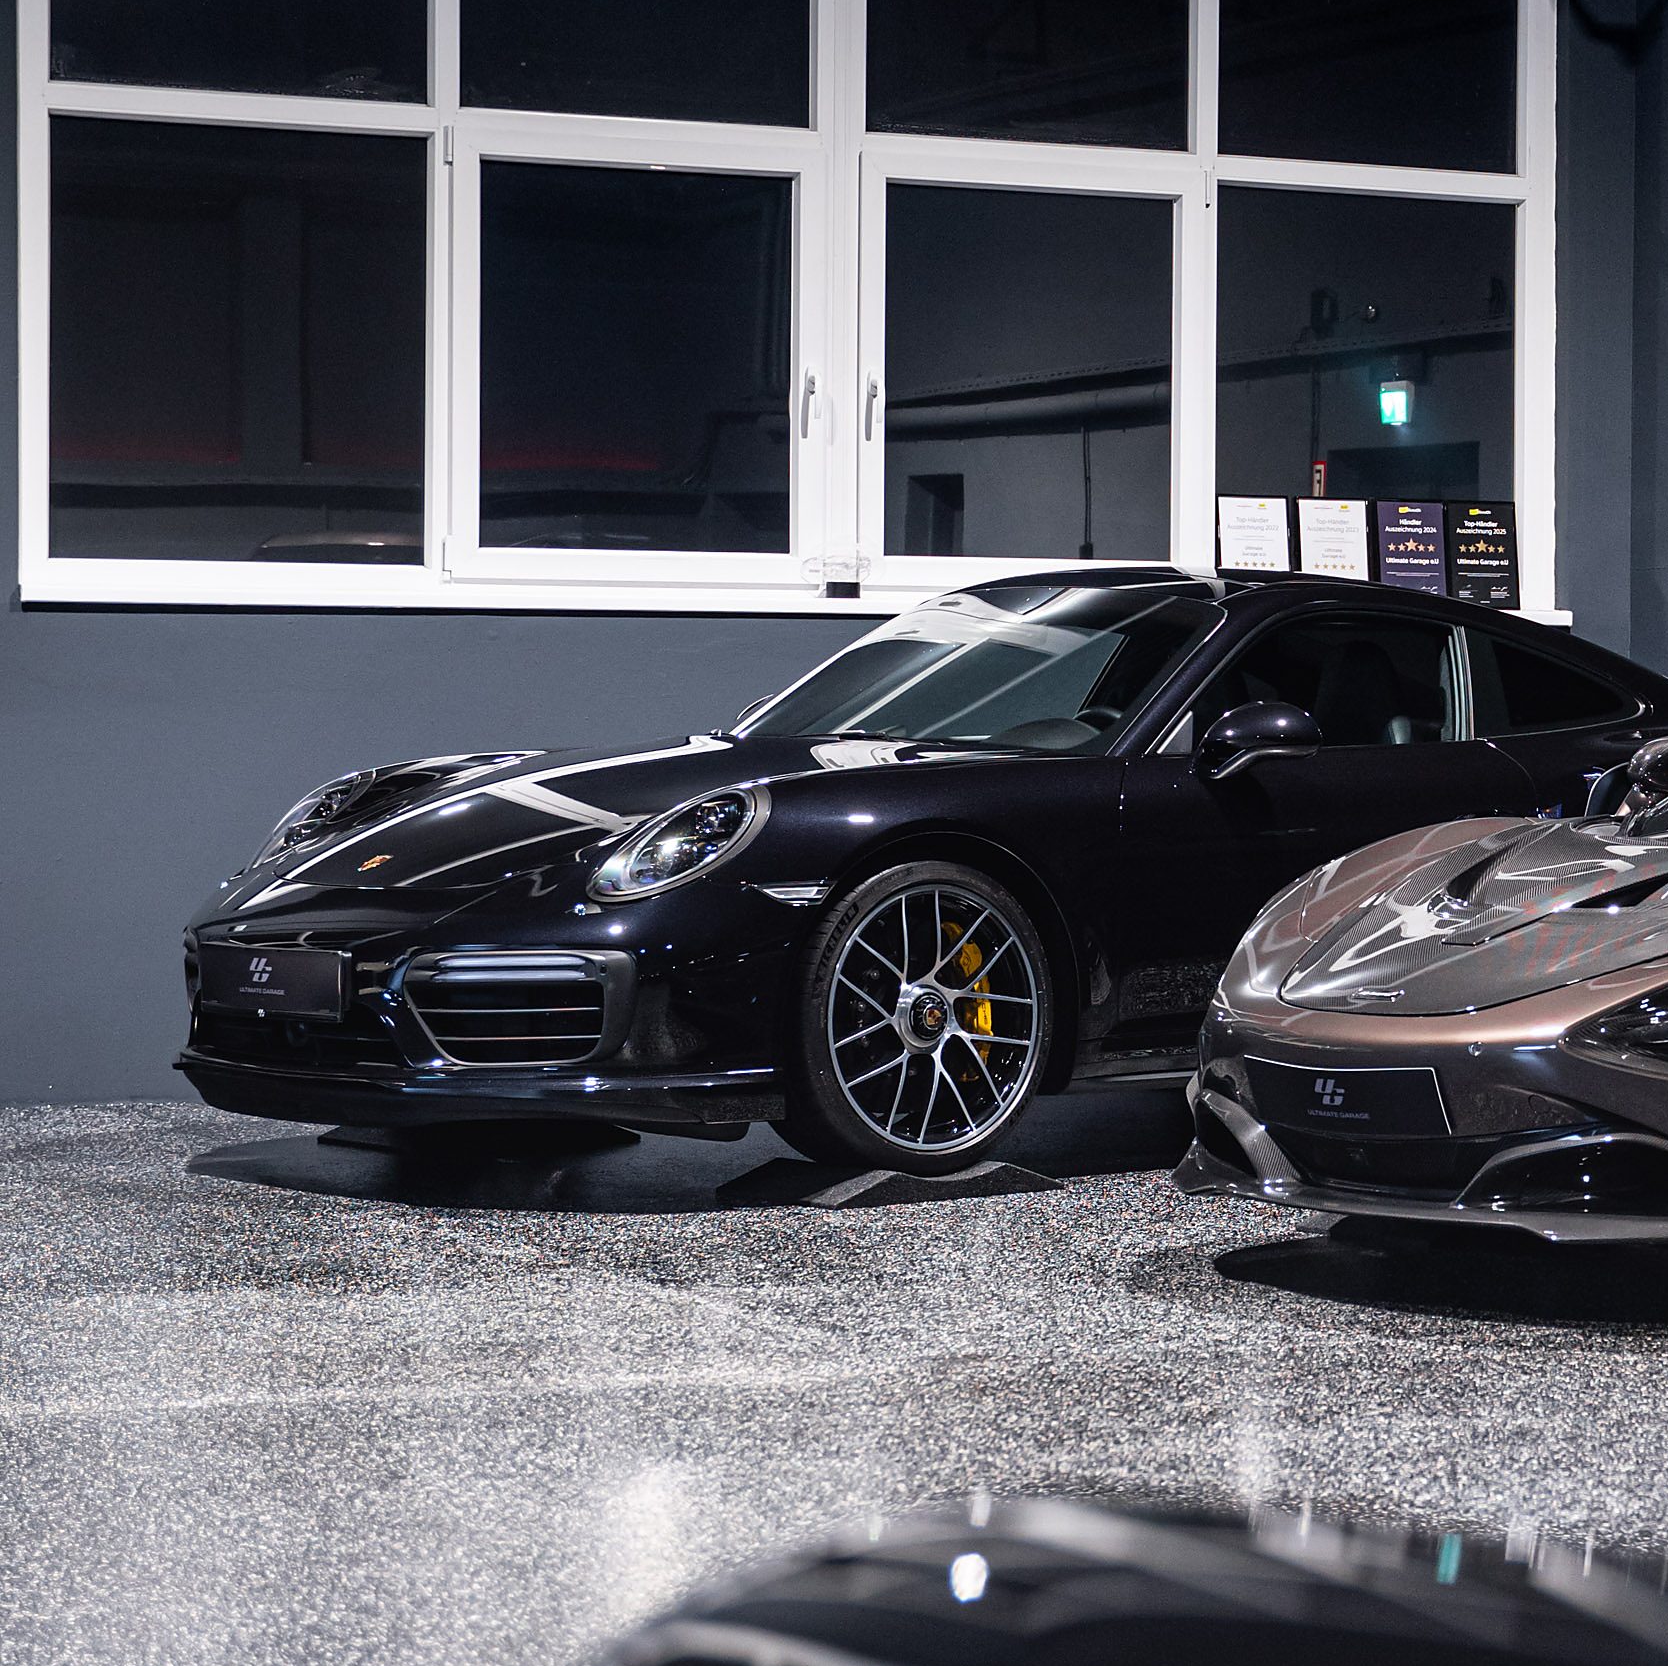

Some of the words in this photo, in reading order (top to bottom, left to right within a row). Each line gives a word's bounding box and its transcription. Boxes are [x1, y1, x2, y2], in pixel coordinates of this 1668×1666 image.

[1464, 520, 1498, 528] Top-Händler
[1385, 526, 1422, 534] Auszeichnung
[1456, 527, 1492, 535] Auszeichnung
[262, 988, 285, 996] GARAGE
[1307, 1109, 1339, 1118] ULTIMATE
[1339, 1111, 1370, 1120] GARAGE
